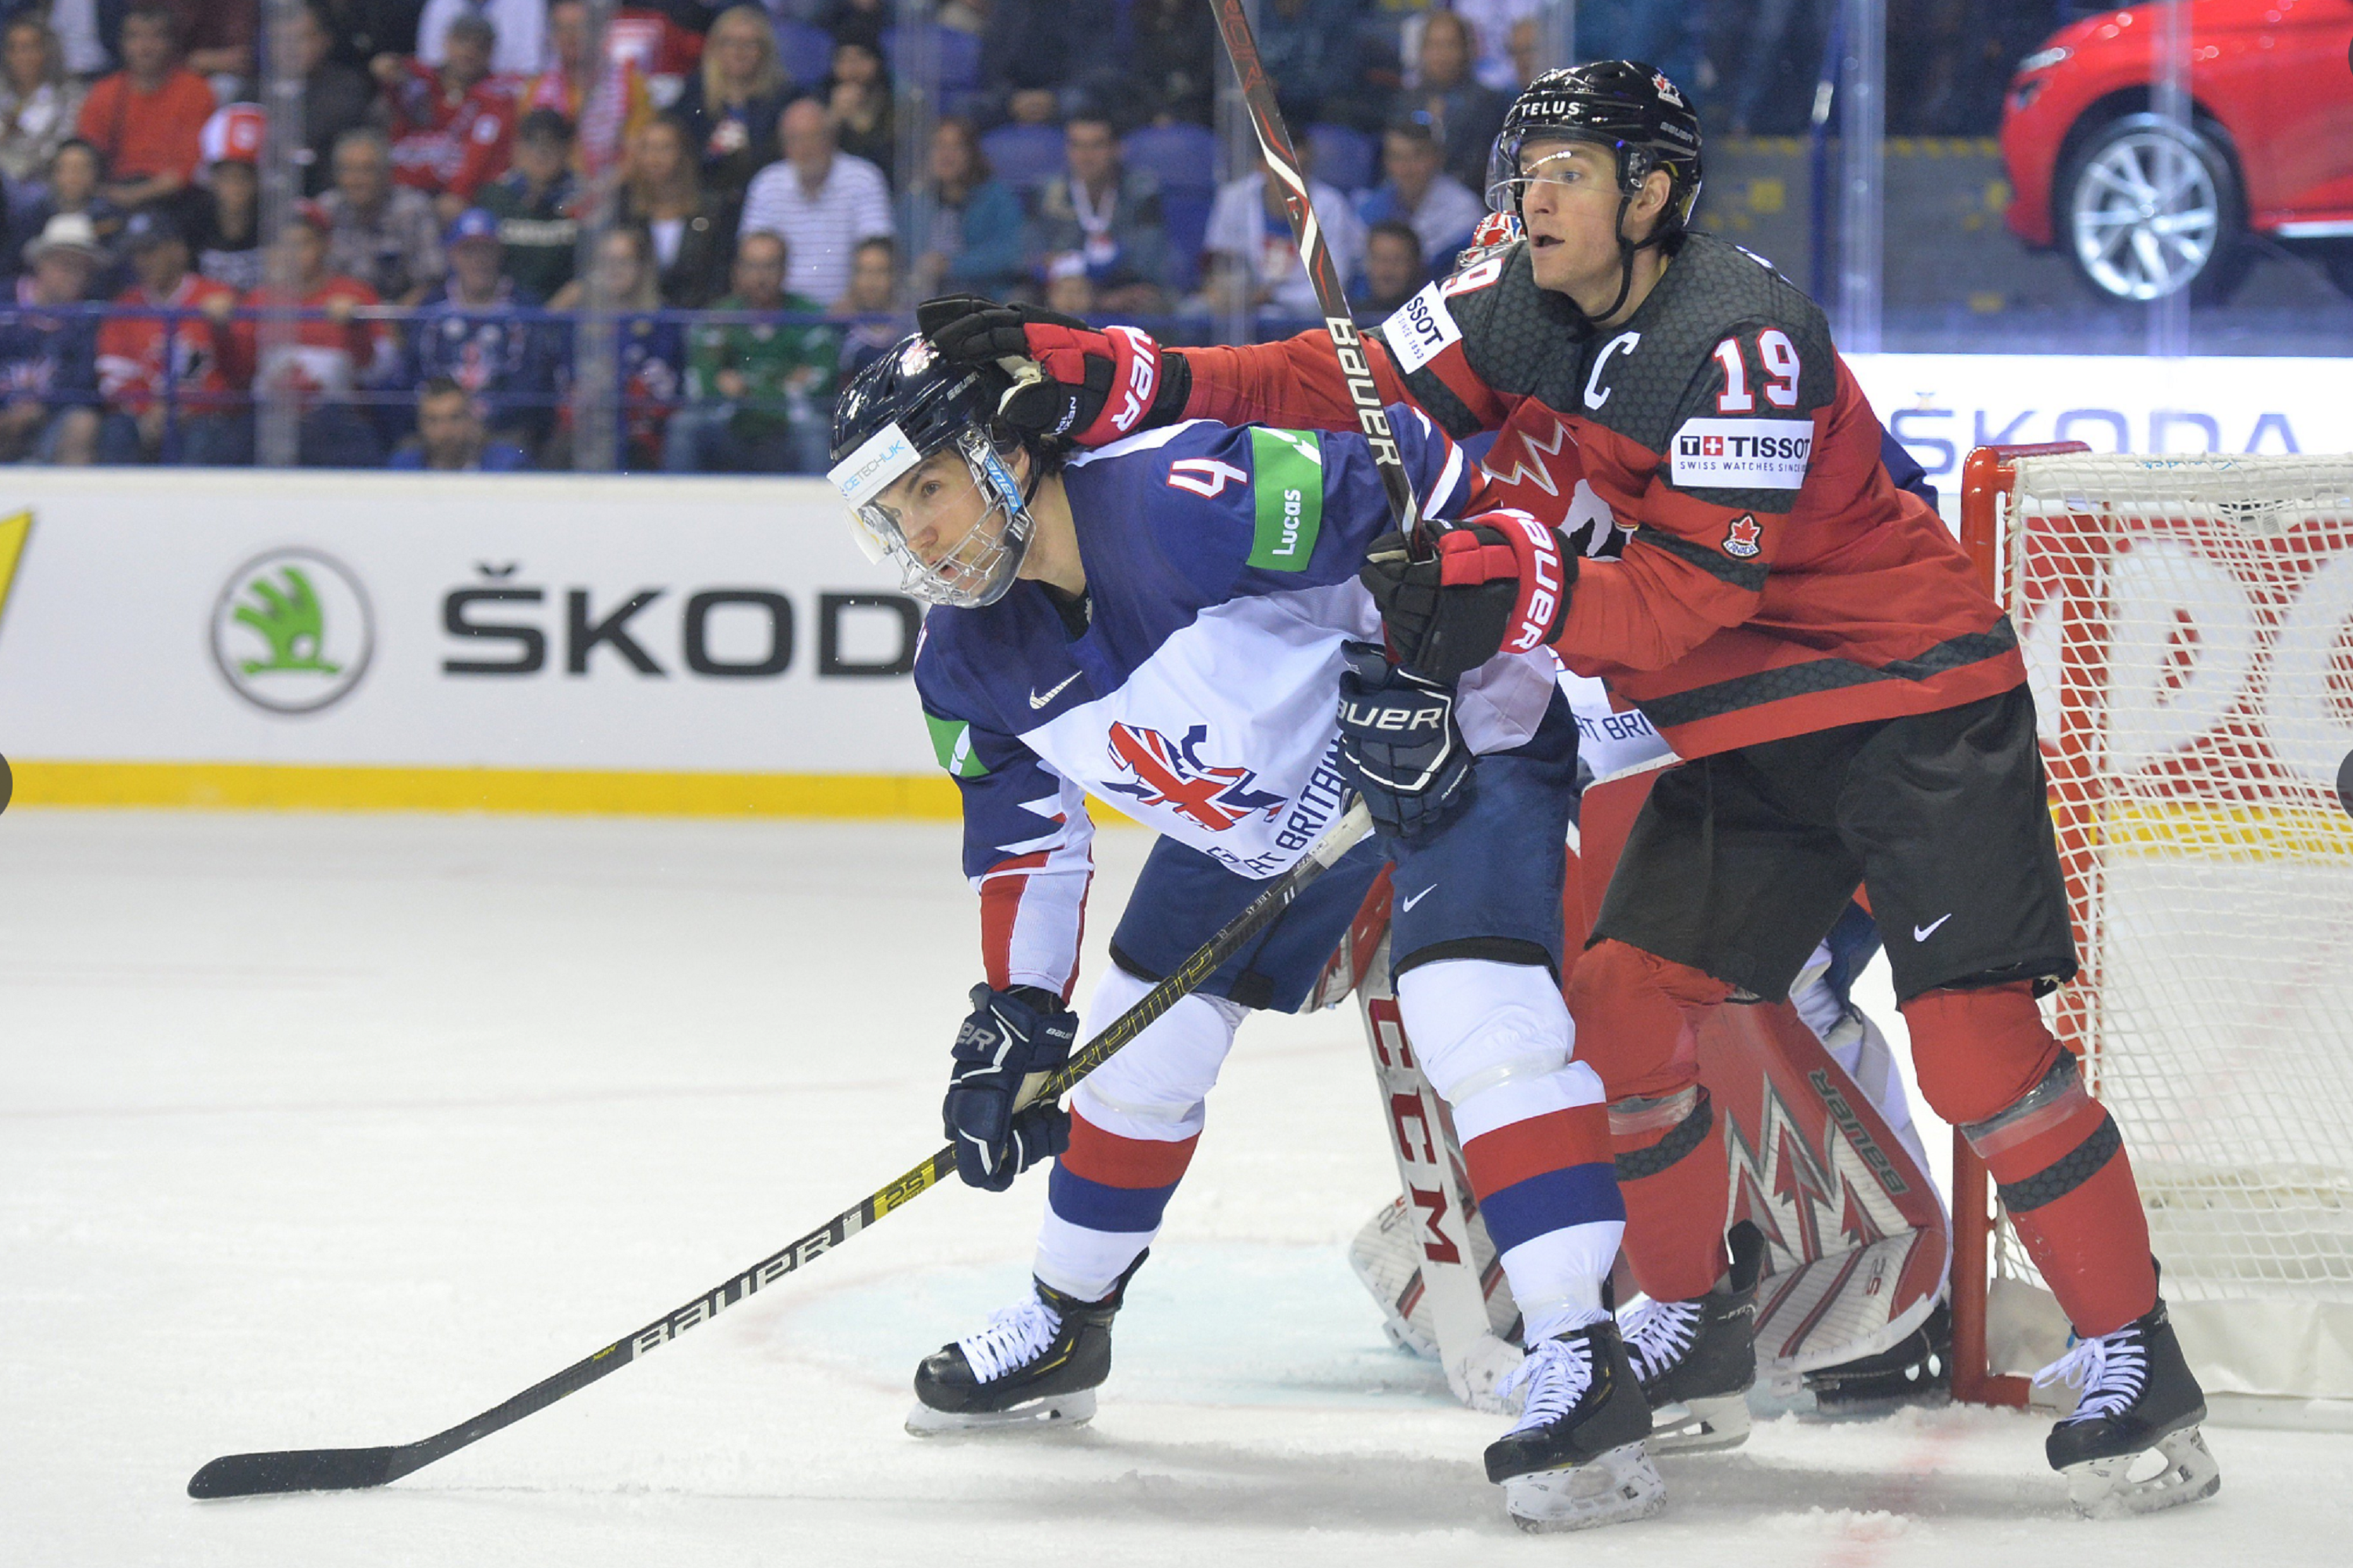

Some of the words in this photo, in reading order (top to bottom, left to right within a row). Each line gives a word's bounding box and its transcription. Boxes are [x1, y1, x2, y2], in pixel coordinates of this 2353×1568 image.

[1521, 100, 1581, 116] TELUS
[1584, 331, 1642, 411] C
[1711, 326, 1802, 414] 19
[1728, 436, 1811, 458] TISSOT
[1891, 391, 2303, 475] ŠKODA
[1166, 457, 1249, 500] 4
[1680, 461, 1717, 471] SWISS
[1722, 462, 1774, 472] WATCHES
[1271, 489, 1301, 555] Lucas
[1726, 540, 1757, 555] CANADA
[1367, 994, 1462, 1265] CCM
